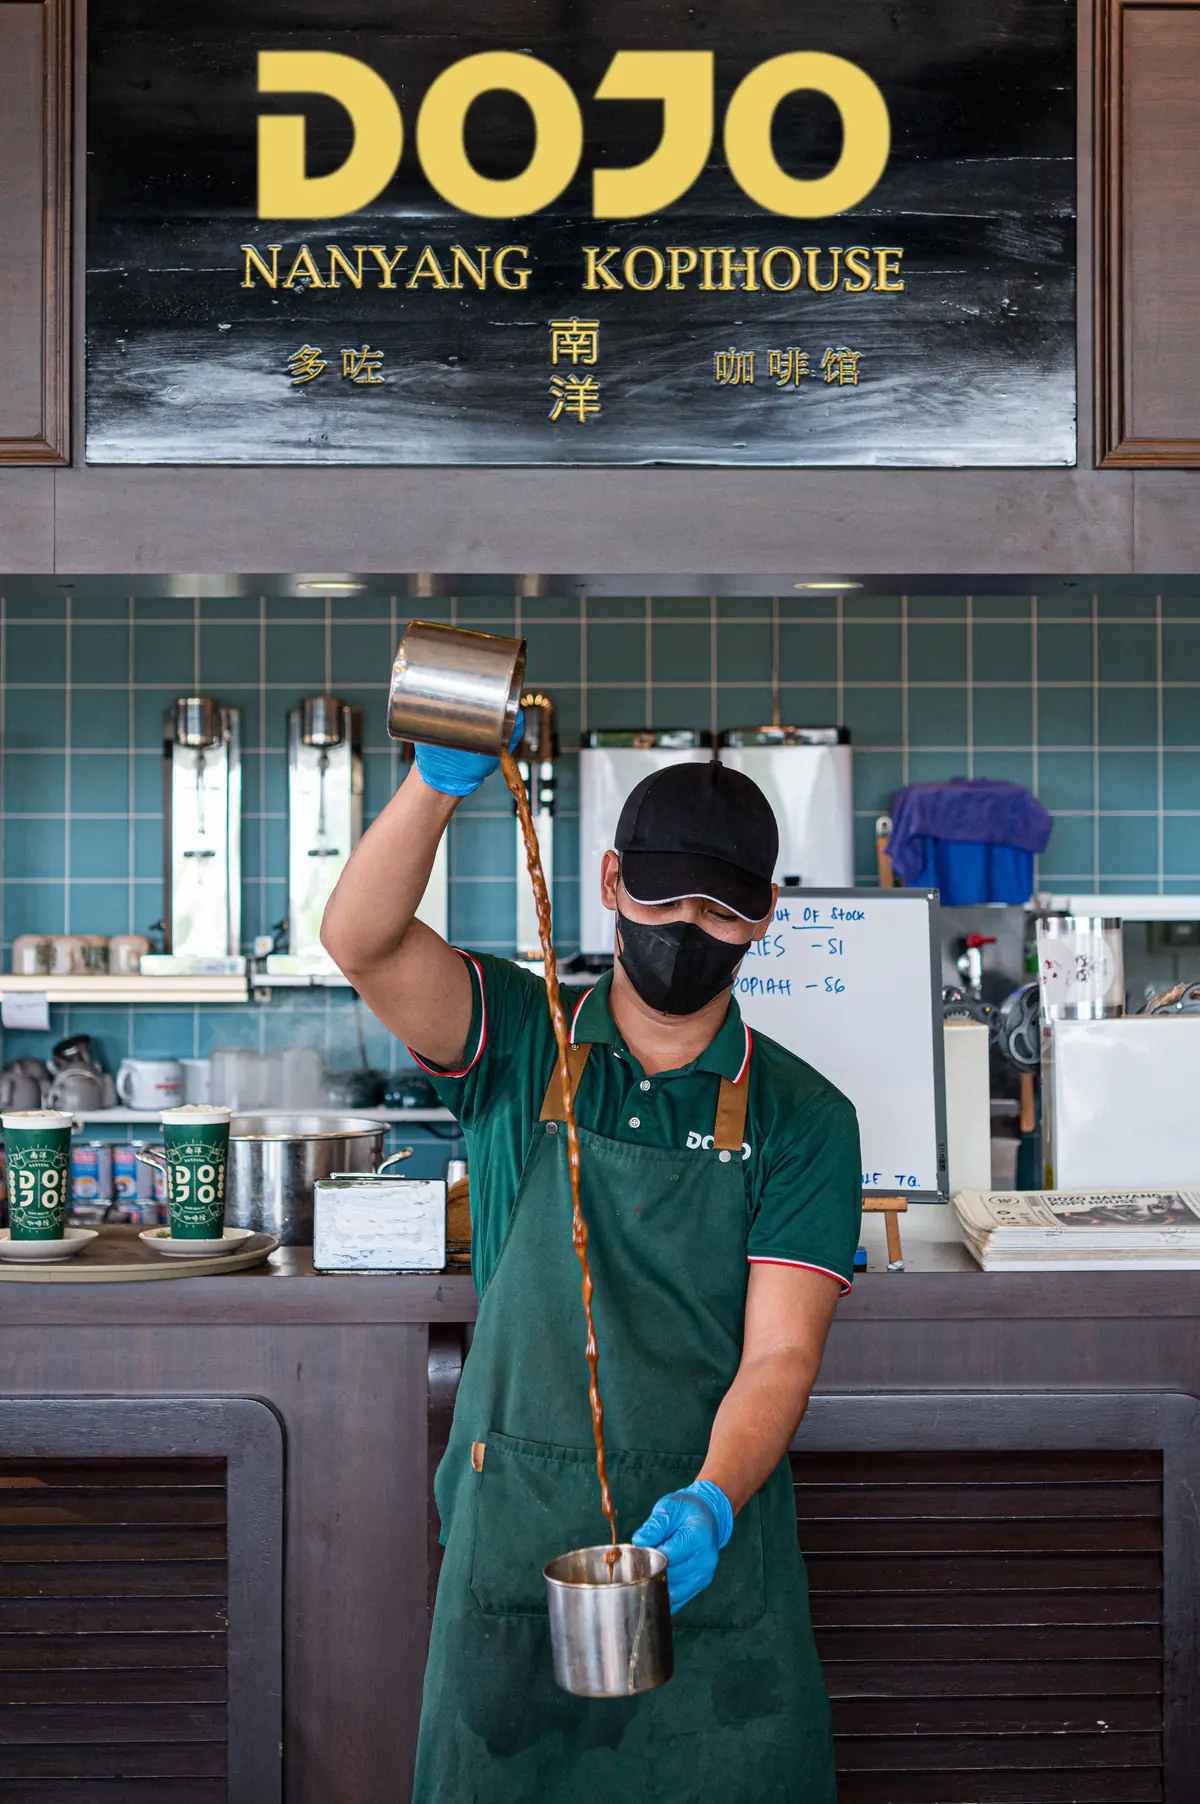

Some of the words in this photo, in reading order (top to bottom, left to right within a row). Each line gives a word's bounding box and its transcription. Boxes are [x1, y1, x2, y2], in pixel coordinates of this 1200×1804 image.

[256, 50, 891, 219] DOJO
[240, 245, 532, 291] NANYANG
[582, 246, 906, 293] KOPIHOUSE
[288, 345, 385, 386] 多咗
[550, 318, 602, 424] 南洋
[713, 347, 862, 386] 咖啡馆
[802, 906, 820, 923] OF
[685, 1130, 752, 1161] DOO
